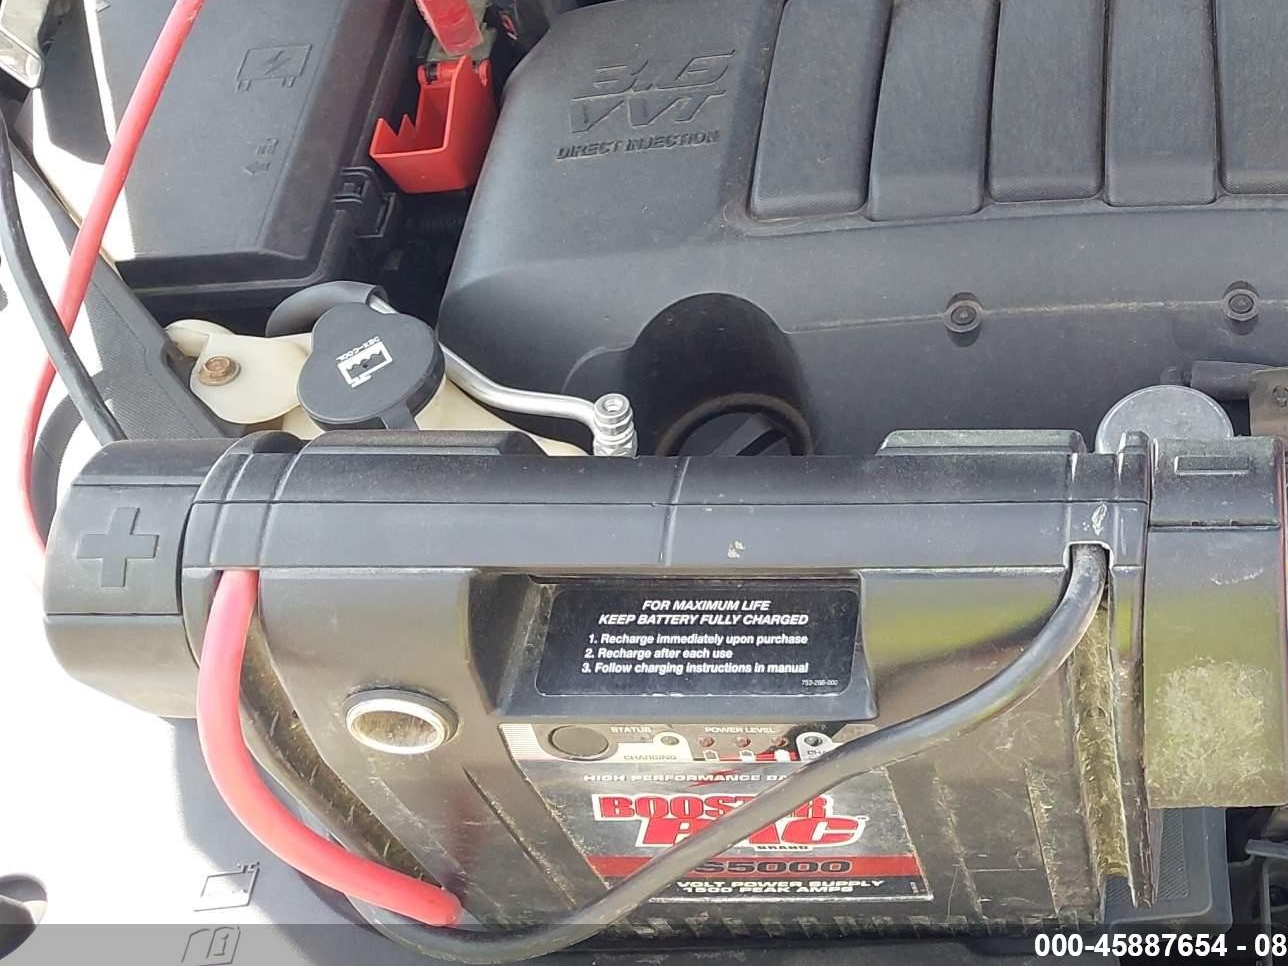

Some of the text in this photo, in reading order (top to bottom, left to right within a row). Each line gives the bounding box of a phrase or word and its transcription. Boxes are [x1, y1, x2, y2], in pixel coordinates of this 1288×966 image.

[568, 89, 727, 134] VVT
[556, 130, 720, 161] DIRECT INJECTION
[642, 600, 771, 611] FOR MAXIMUM LIFE
[598, 614, 809, 625] KEEP BATTERY FULLY CHARGED
[589, 634, 808, 646] 1. Recharge immediately upon purchase
[584, 647, 733, 660] 2. Recharge after each use
[581, 662, 809, 675] 3. Follow charging instructions in manual
